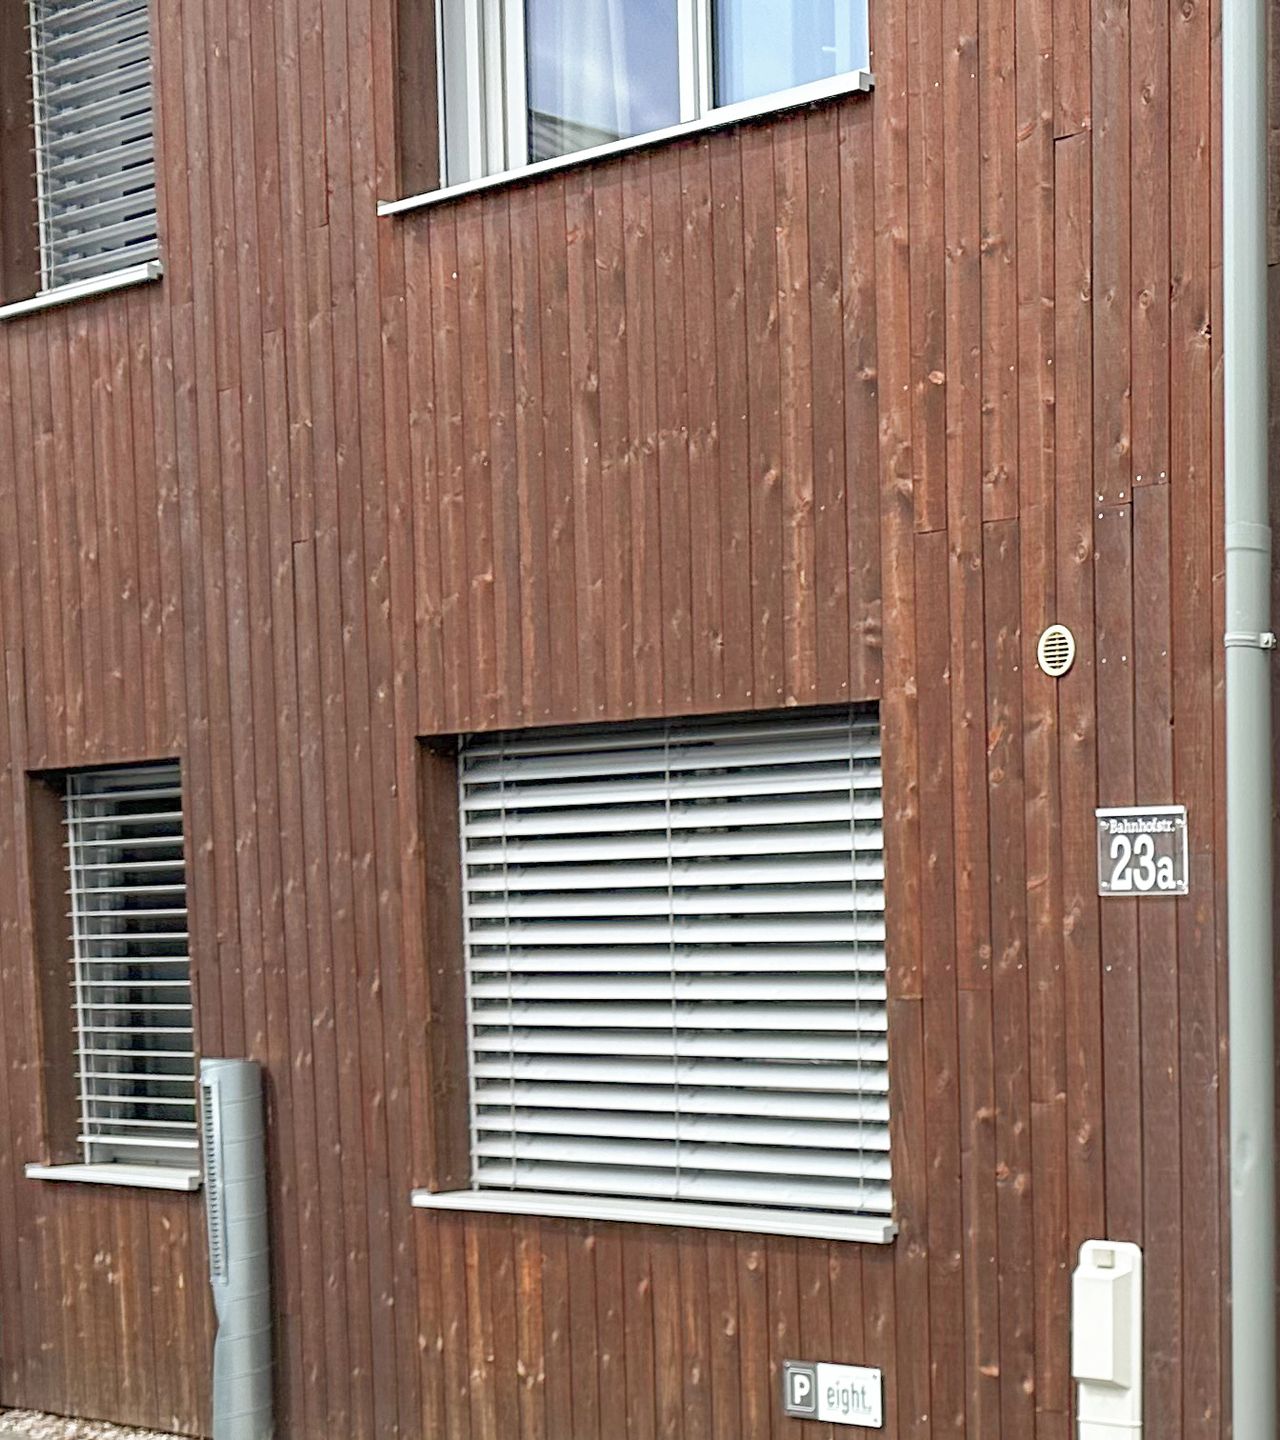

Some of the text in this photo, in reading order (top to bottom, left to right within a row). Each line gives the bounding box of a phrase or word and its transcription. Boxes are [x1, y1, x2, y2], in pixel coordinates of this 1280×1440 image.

[1109, 817, 1176, 833] Bahnhofstr.
[1110, 834, 1177, 891] 23a
[793, 1374, 811, 1405] P
